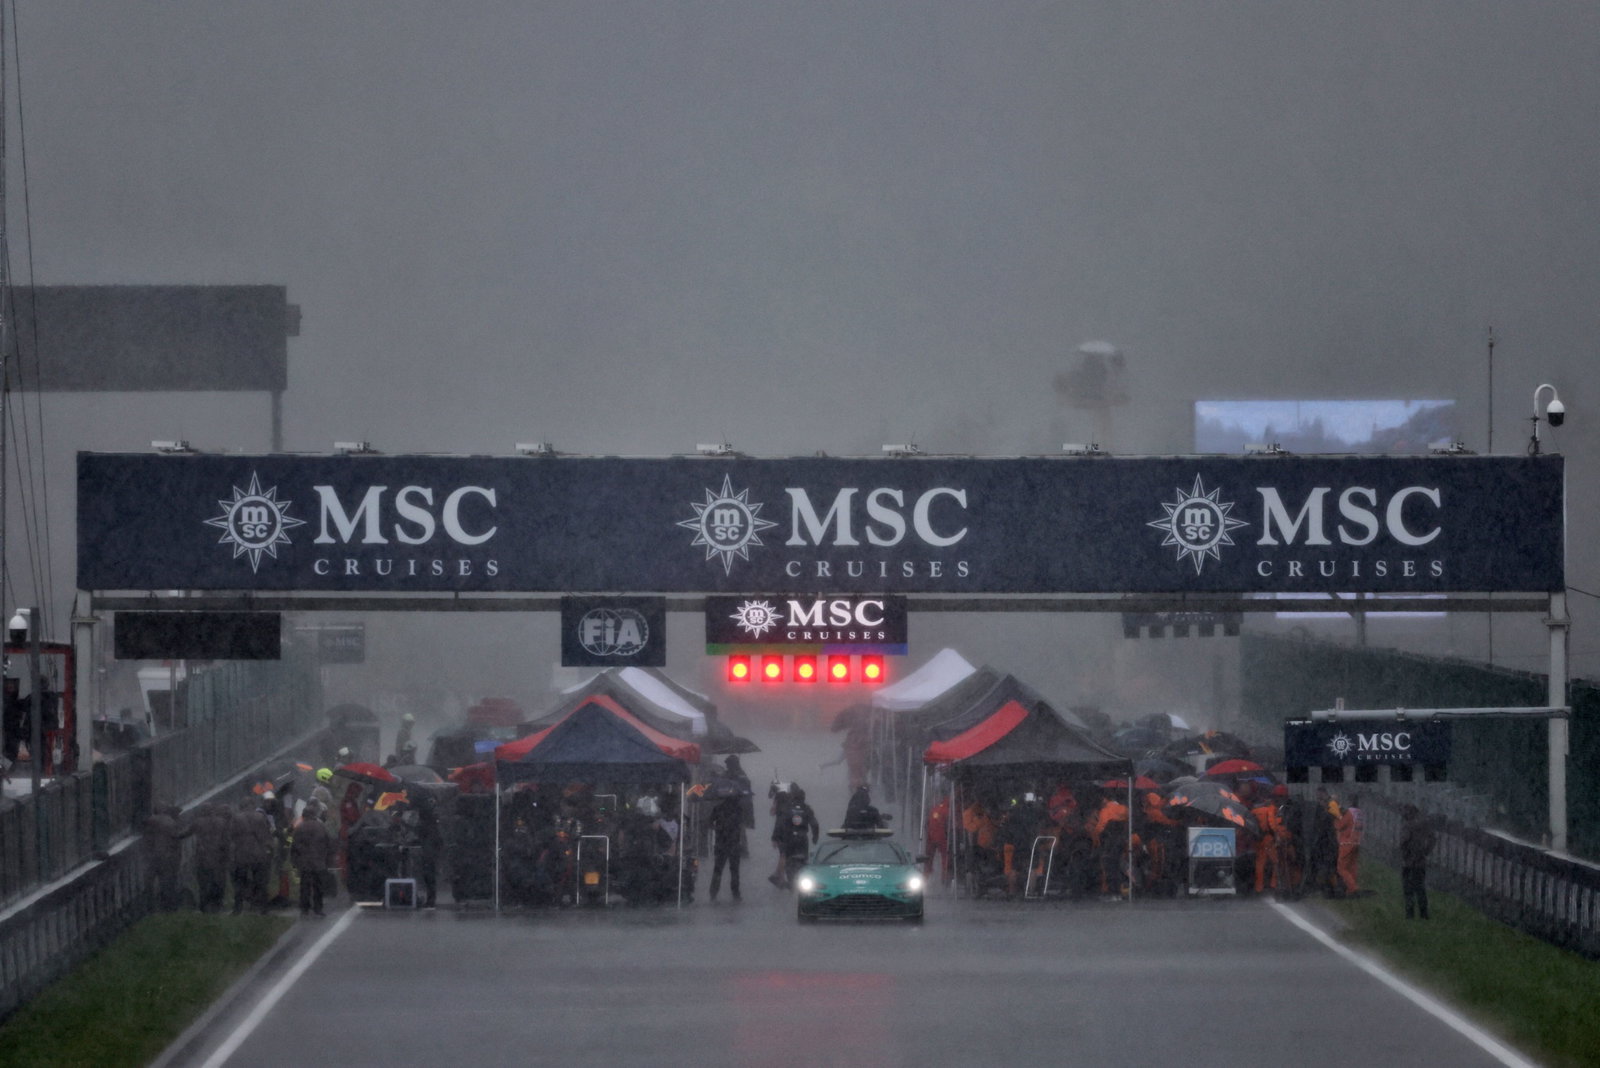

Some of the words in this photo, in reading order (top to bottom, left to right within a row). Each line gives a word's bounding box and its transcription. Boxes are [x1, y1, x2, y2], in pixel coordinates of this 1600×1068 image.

[312, 485, 498, 545] MSC
[784, 486, 968, 547] MSC
[1256, 486, 1442, 546] MSC
[313, 558, 499, 576] CRUISES
[785, 560, 970, 578] CRUISES
[1257, 560, 1443, 577] CRUISES
[786, 599, 885, 627] MSC
[786, 631, 885, 640] CRUISES
[1357, 732, 1411, 751] MSC
